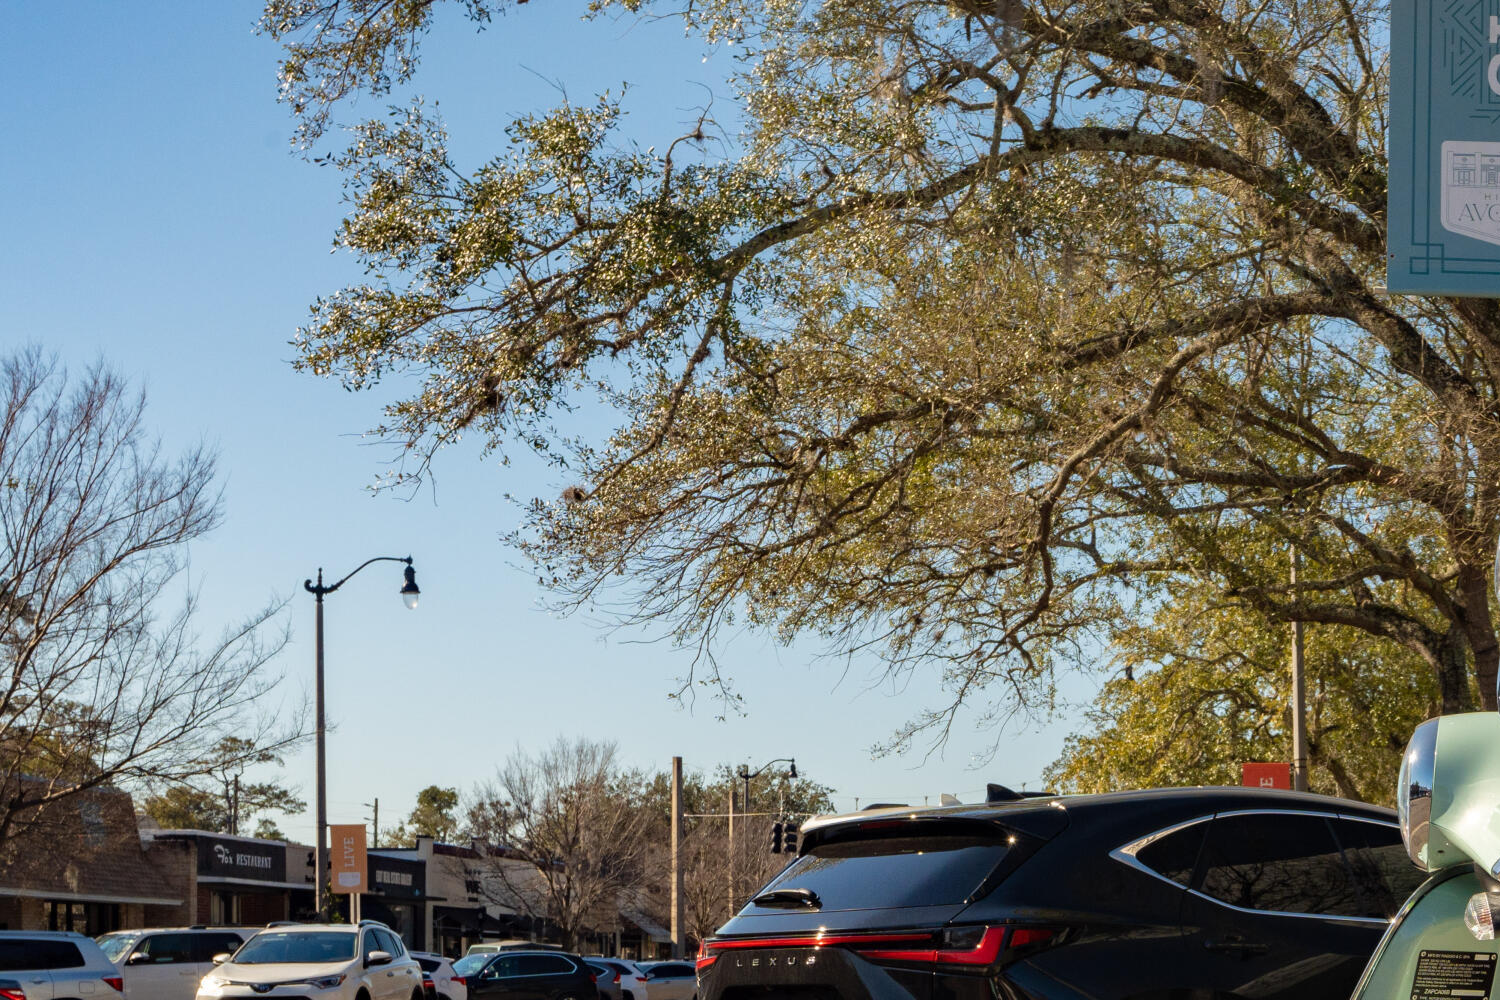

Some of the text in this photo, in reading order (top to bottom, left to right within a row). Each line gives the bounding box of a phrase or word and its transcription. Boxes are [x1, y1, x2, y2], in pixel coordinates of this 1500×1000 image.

[344, 837, 354, 867] LIVE
[236, 853, 272, 869] RESTAURANT
[736, 956, 817, 967] LEXUS
